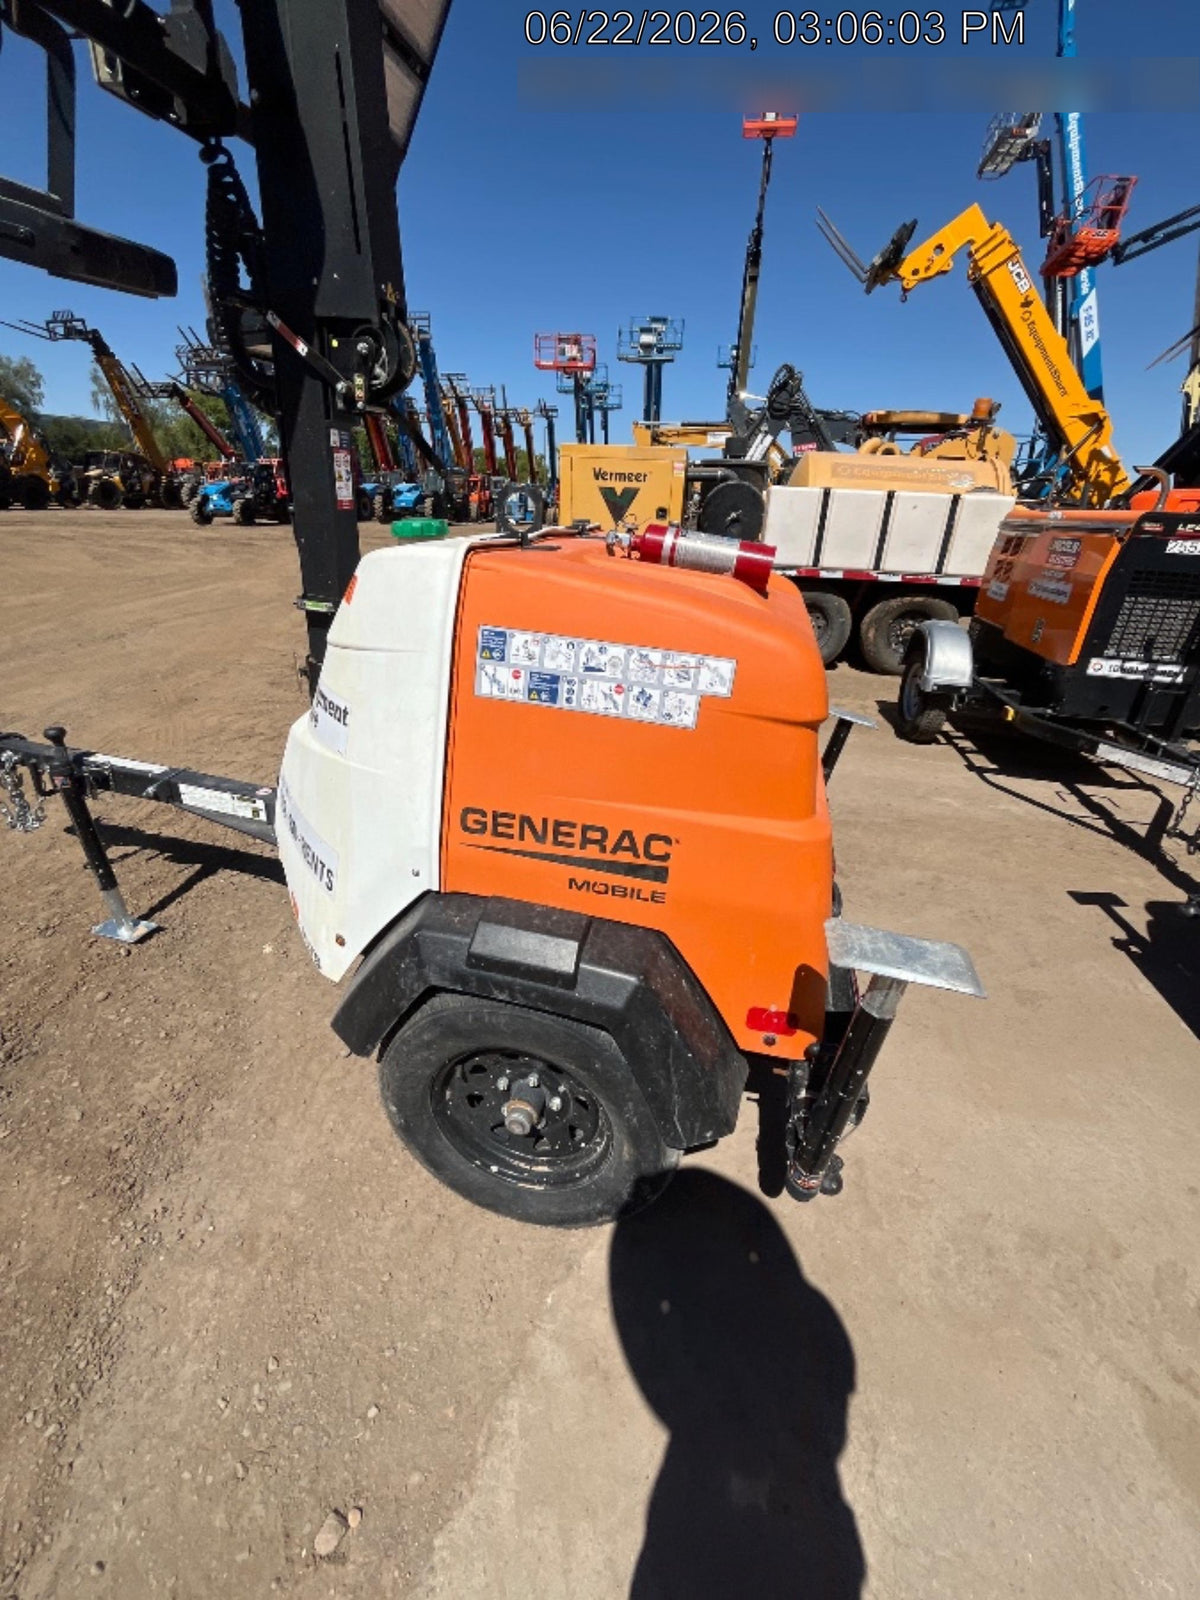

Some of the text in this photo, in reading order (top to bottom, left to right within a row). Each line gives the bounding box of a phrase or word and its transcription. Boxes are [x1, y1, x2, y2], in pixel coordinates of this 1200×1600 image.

[1007, 260, 1031, 294] JCB
[593, 467, 648, 482] Vermeer
[460, 807, 673, 862] GENERAC
[568, 877, 667, 904] MOBILE
